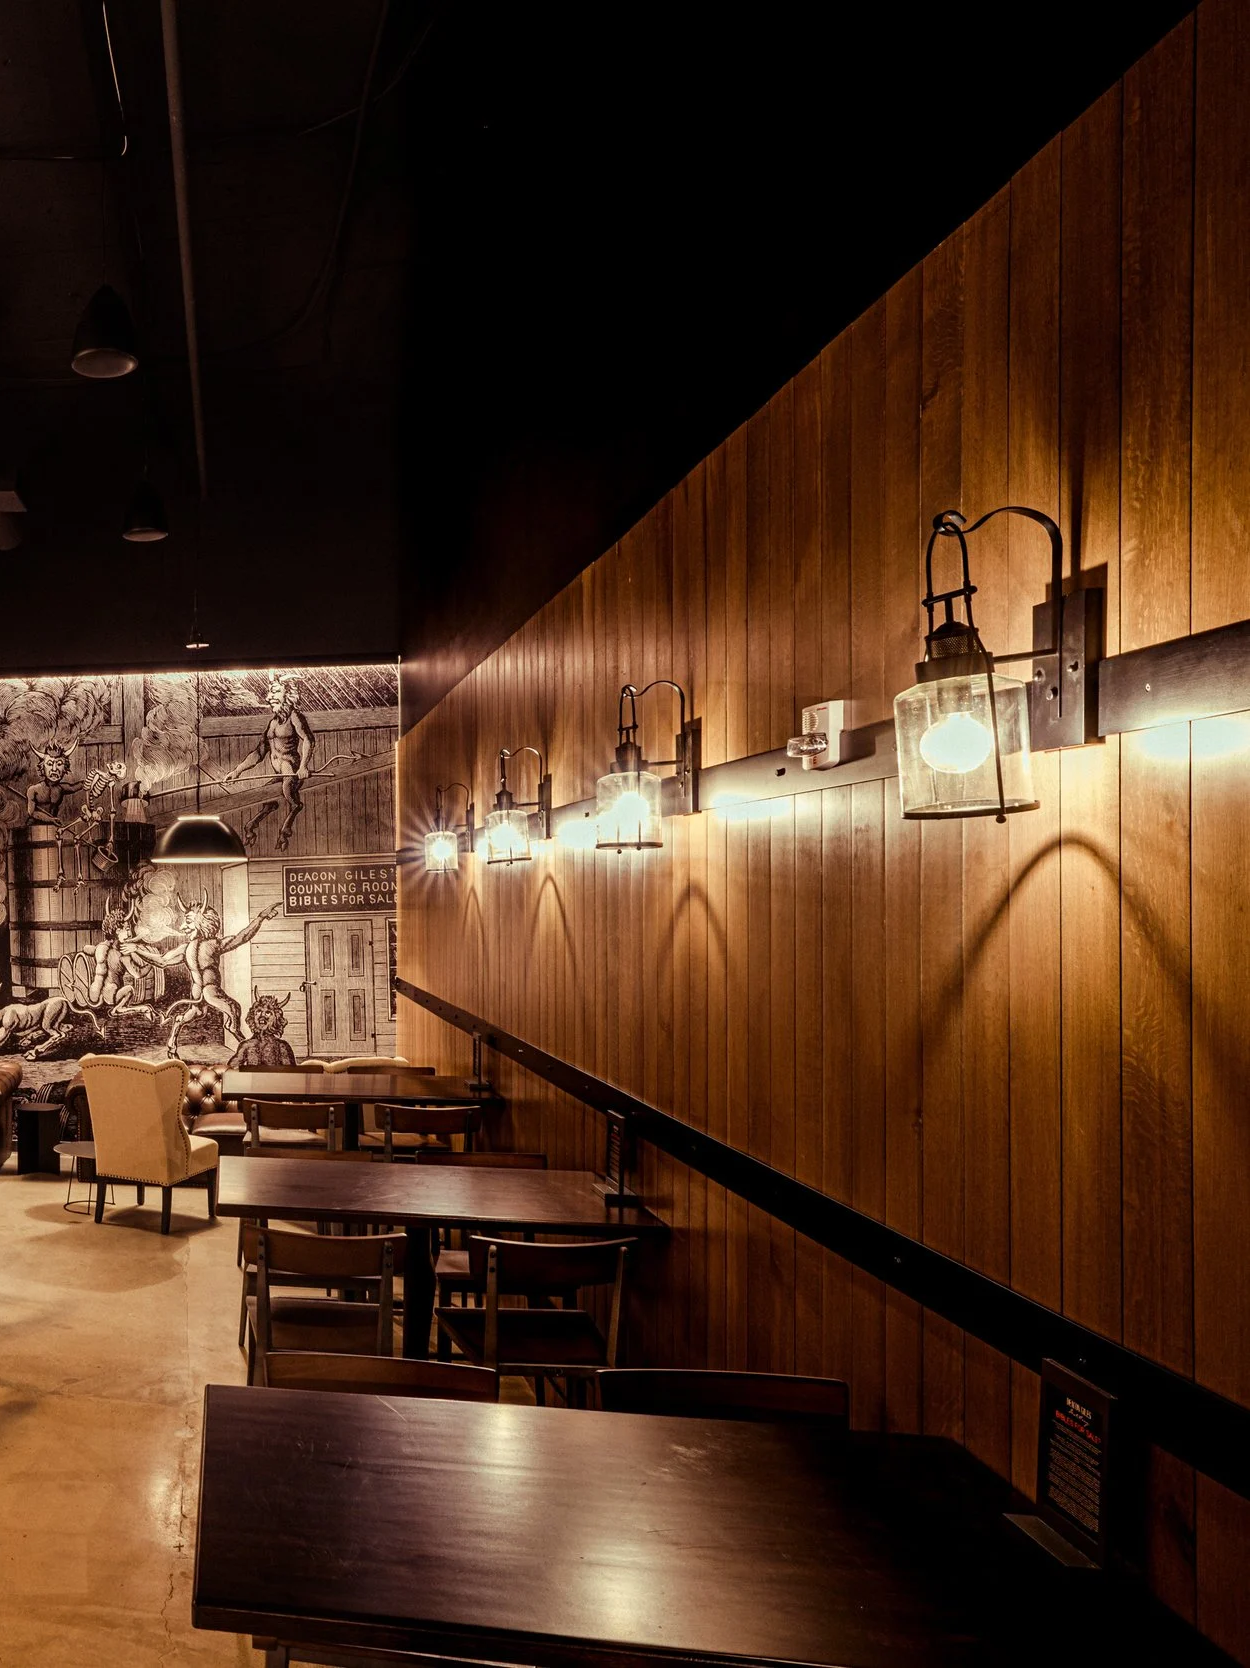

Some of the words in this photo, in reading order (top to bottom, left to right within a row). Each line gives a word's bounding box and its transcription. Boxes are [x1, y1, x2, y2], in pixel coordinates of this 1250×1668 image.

[290, 871, 337, 882] DEACON
[290, 883, 356, 894] COUNTING
[289, 894, 338, 906] BIBLES
[341, 894, 365, 905] FOR
